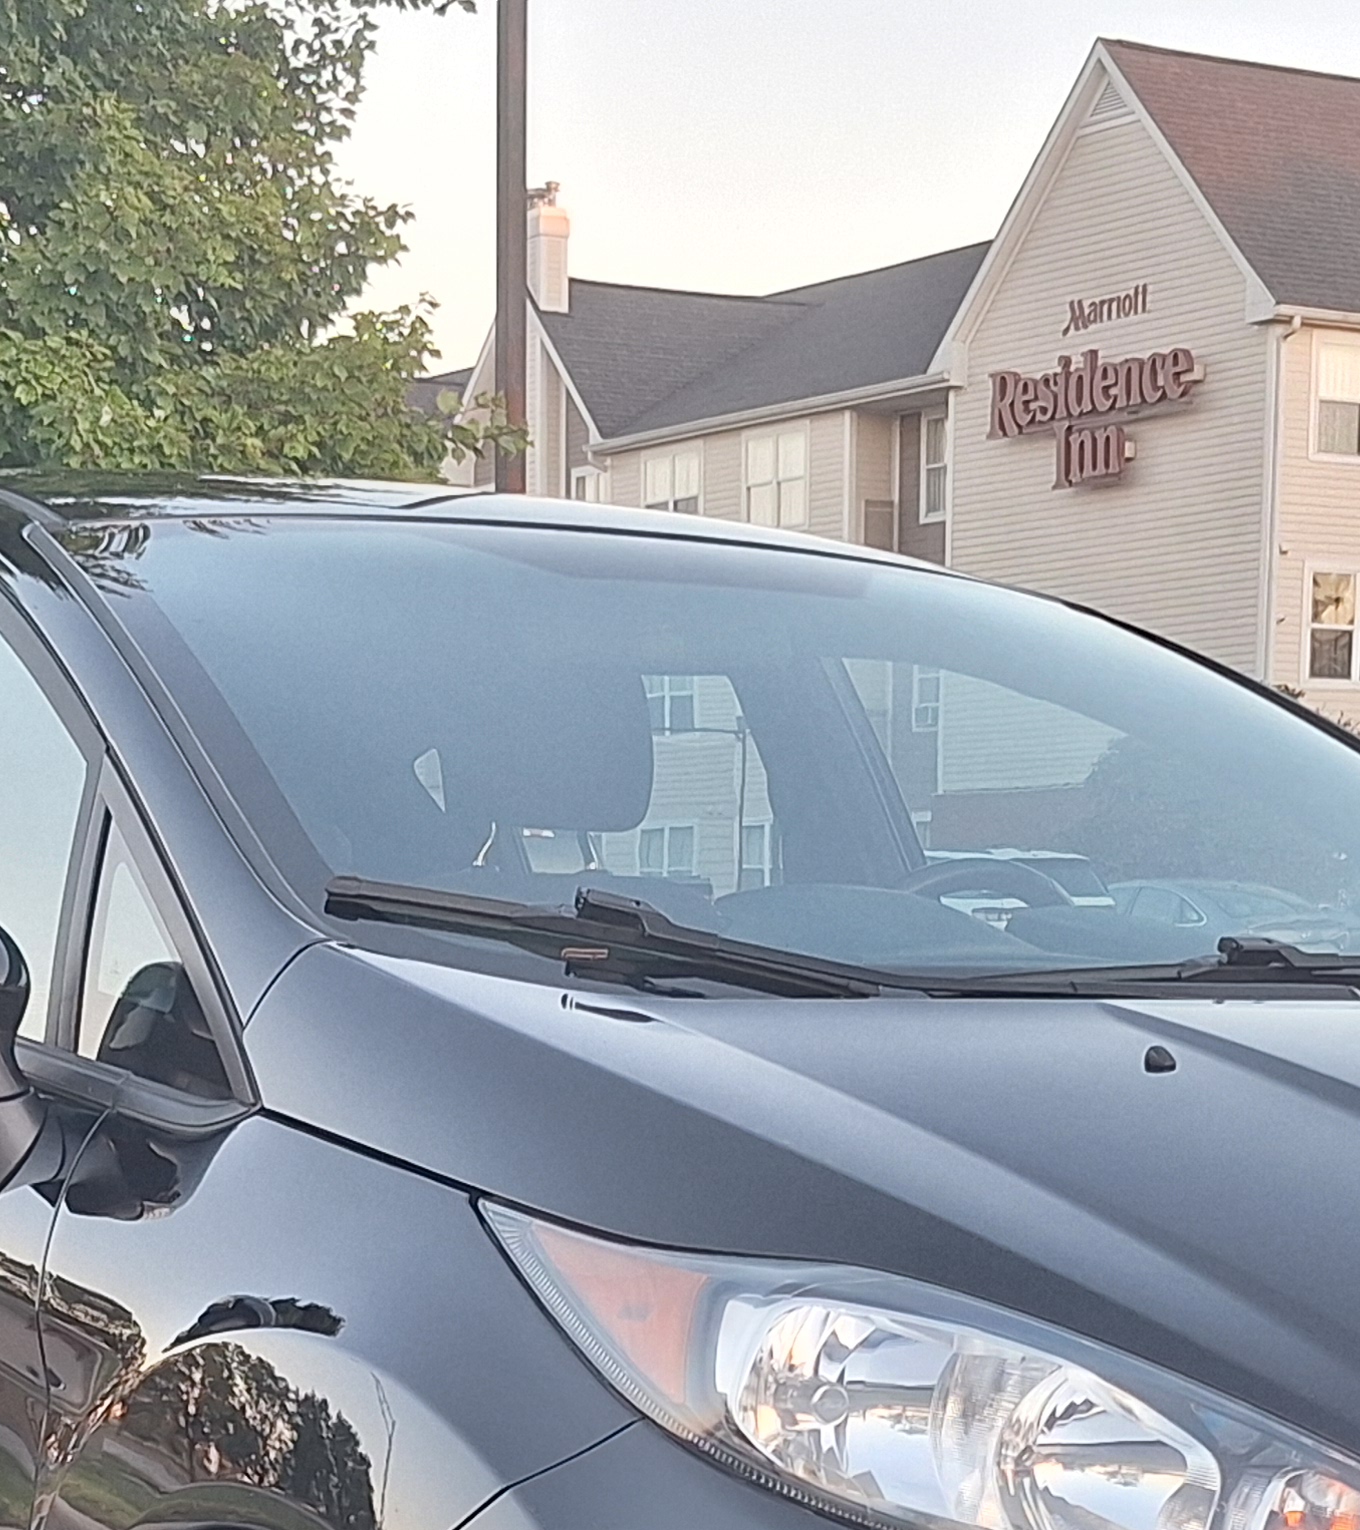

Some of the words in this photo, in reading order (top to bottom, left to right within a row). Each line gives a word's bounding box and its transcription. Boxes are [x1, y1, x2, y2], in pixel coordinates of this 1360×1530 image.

[1062, 283, 1149, 337] Marriott
[986, 348, 1195, 439] Residence
[1051, 421, 1125, 490] Inn
